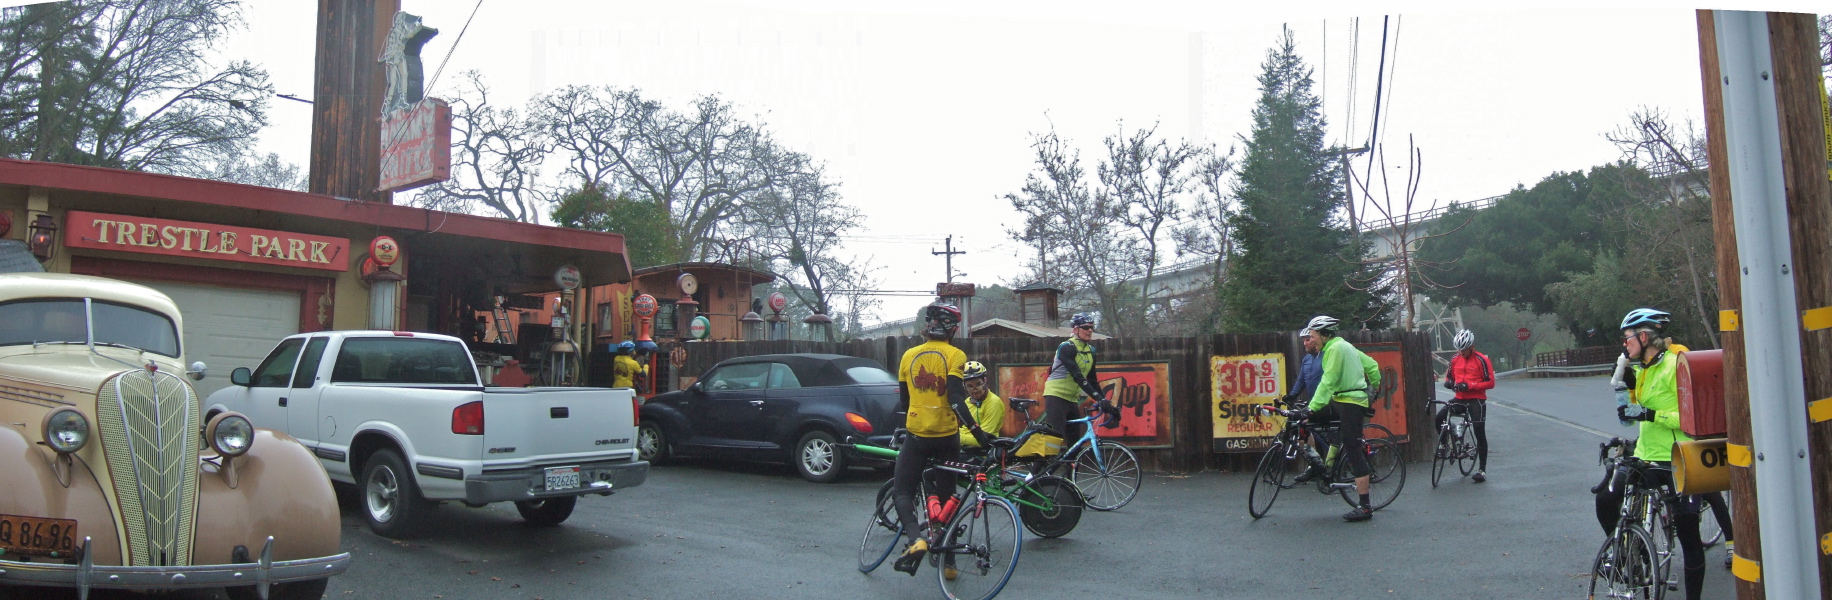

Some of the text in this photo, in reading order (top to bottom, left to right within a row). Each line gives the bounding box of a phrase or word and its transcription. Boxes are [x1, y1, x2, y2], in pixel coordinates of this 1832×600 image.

[93, 219, 331, 264] TRESTLE PARK
[1261, 362, 1273, 377] 9
[1220, 363, 1256, 395] 30
[1260, 379, 1276, 394] 10
[1003, 379, 1038, 397] Fresh
[1227, 423, 1273, 433] REGULAR
[547, 475, 579, 488] 5R26263
